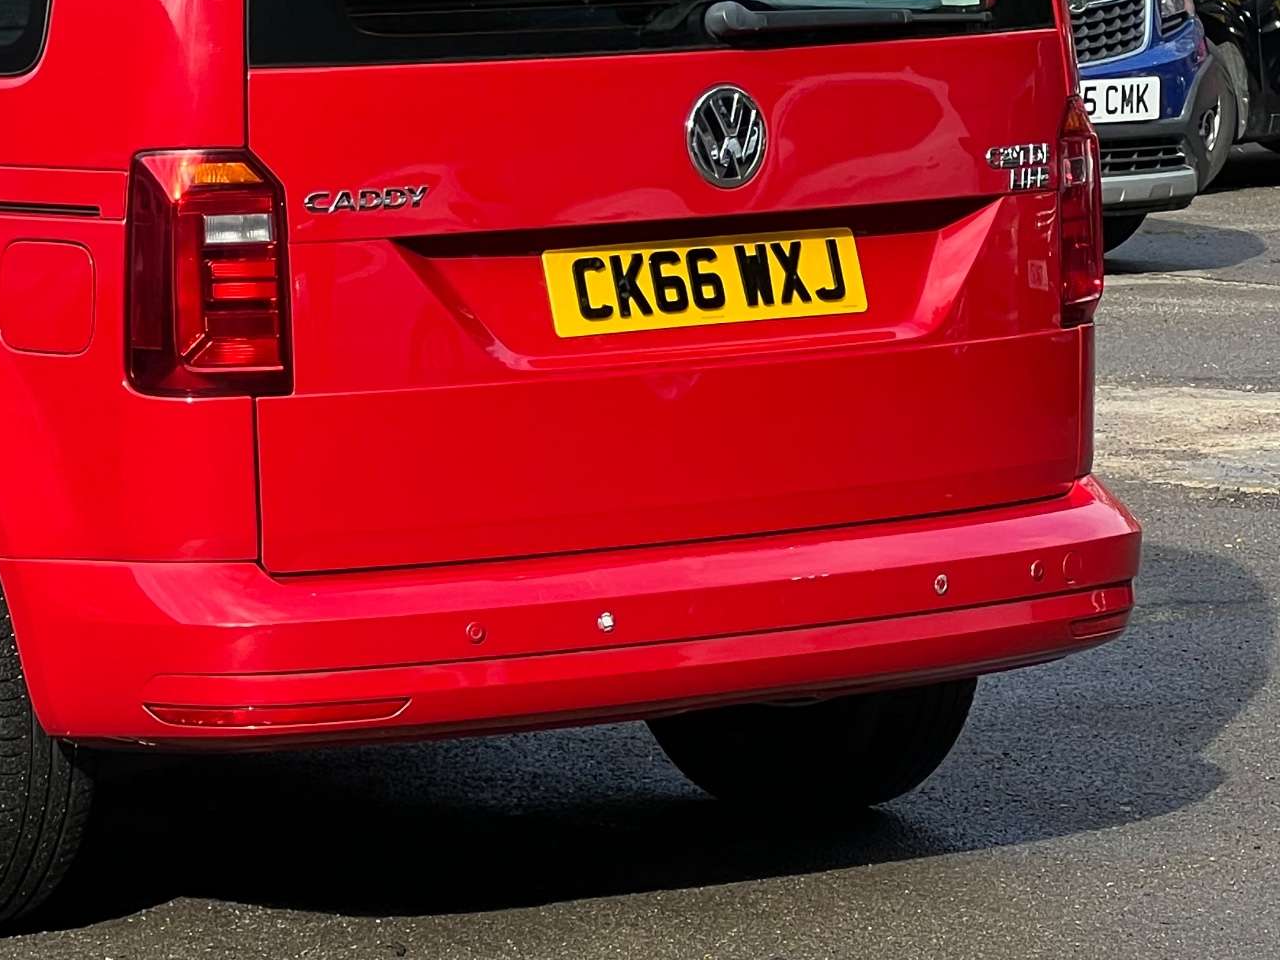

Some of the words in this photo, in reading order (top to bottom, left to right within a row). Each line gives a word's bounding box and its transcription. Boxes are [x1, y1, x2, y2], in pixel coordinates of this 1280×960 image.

[1105, 83, 1149, 115] CMK
[303, 185, 429, 214] CADDY
[571, 247, 726, 321] CK66
[733, 238, 847, 307] WXJ
